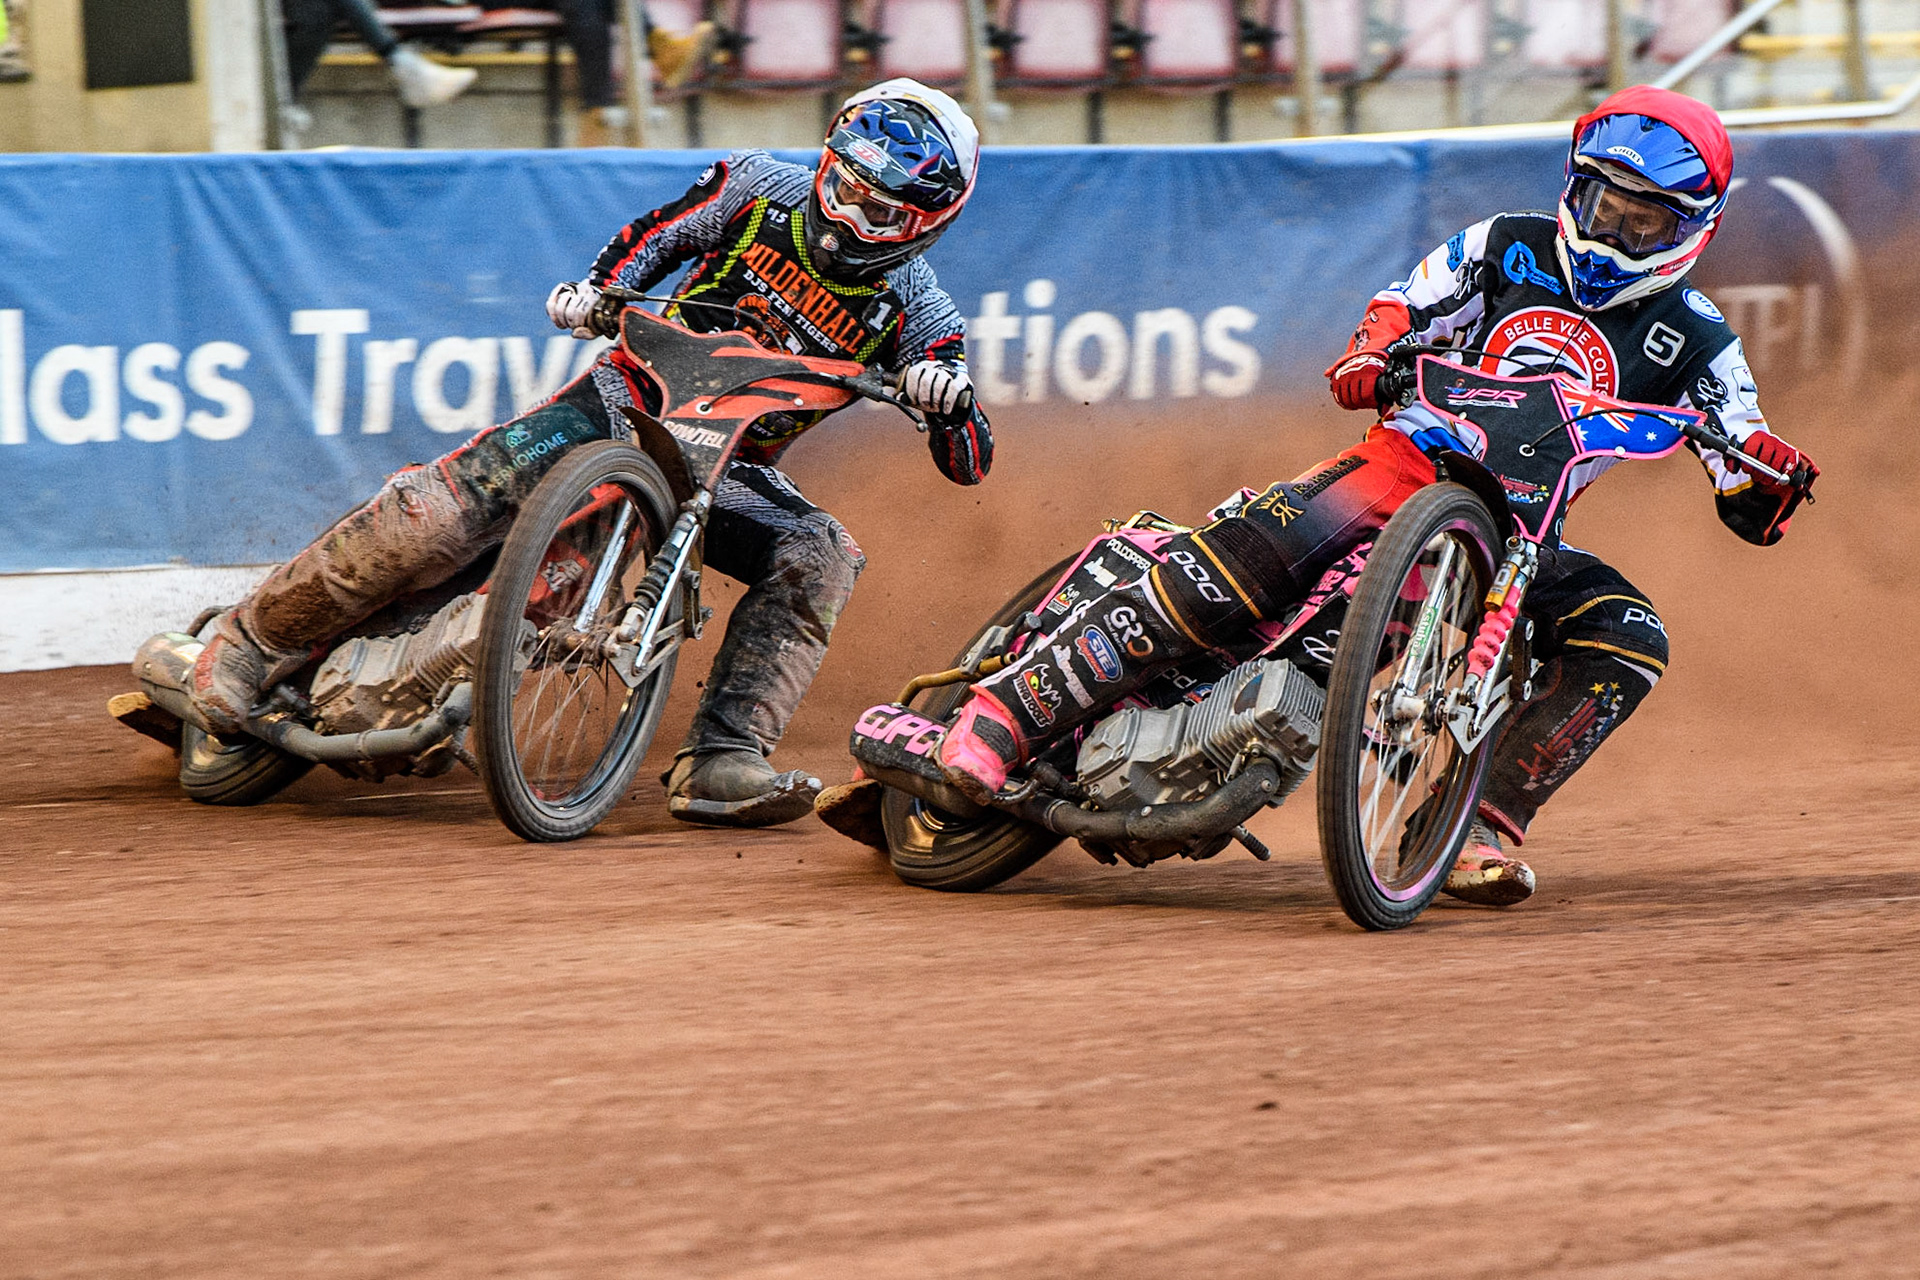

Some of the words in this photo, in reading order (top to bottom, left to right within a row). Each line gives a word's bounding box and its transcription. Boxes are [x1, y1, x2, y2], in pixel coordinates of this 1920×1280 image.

[741, 242, 866, 354] MILDENHALL
[743, 269, 769, 293] DJS
[795, 309, 839, 354] TIGERS
[868, 301, 892, 331] 1
[1714, 284, 1822, 370] TPI
[969, 279, 1261, 405] tions
[1504, 317, 1553, 342] BELLE
[1559, 319, 1592, 346] VUE
[1588, 346, 1610, 397] COLTS
[1645, 327, 1680, 362] 5
[1447, 388, 1528, 408] JPR
[1106, 538, 1152, 572] POLCOPPER
[1089, 635, 1116, 672] STE
